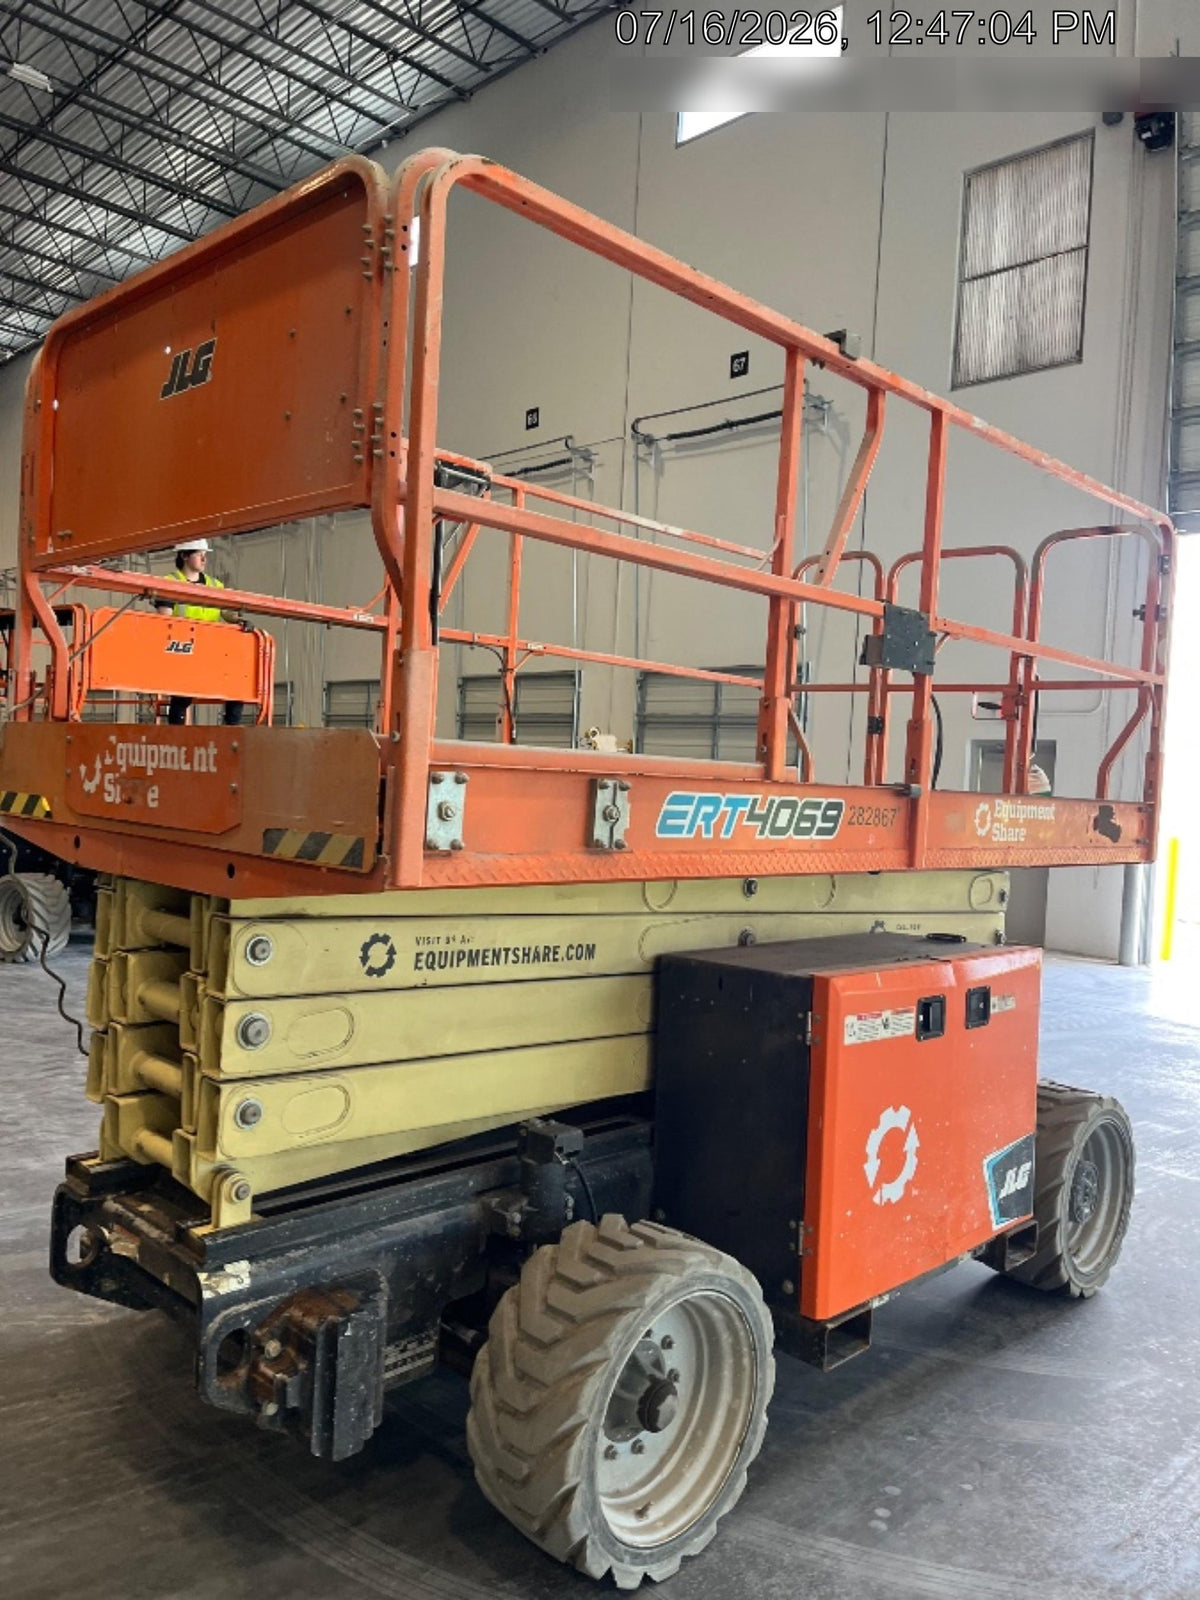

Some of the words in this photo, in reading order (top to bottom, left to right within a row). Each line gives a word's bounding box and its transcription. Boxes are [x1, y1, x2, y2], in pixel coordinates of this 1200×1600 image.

[160, 338, 217, 400] JLG
[165, 640, 194, 655] JLG
[656, 791, 845, 839] ERT4069
[848, 805, 898, 827] 282867
[994, 799, 1056, 823] Equipment
[992, 823, 1026, 842] Share
[413, 943, 597, 971] EQUIPMENTSHARE.COM
[998, 1161, 1033, 1200] JLG
